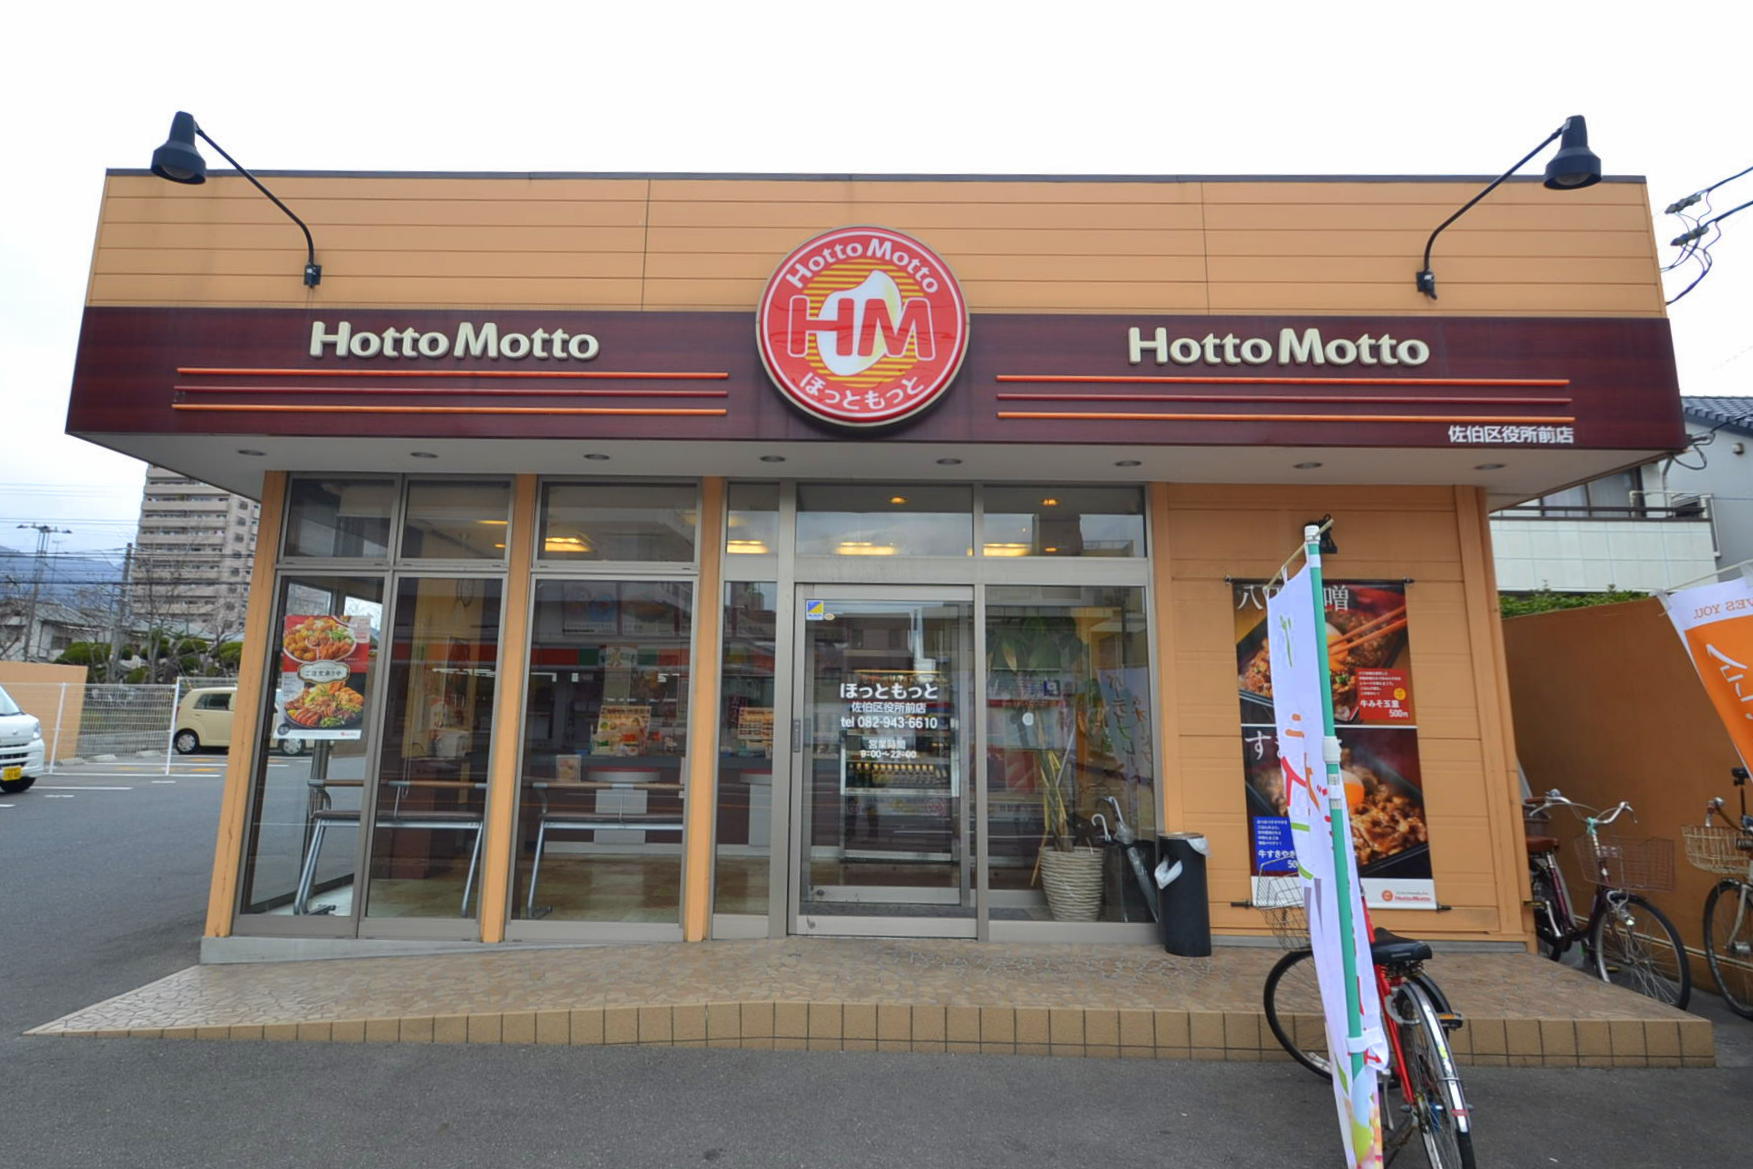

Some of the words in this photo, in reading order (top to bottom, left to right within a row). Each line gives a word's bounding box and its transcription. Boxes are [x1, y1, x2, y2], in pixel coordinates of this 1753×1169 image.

[799, 373, 924, 410] ほっともっと
[1447, 425, 1575, 445] 佐伯区役所前店
[839, 683, 939, 700] ほっともっと
[851, 702, 927, 714] 佐伯区役所前店
[840, 717, 855, 728] tel
[857, 716, 938, 729] 082-943-6610
